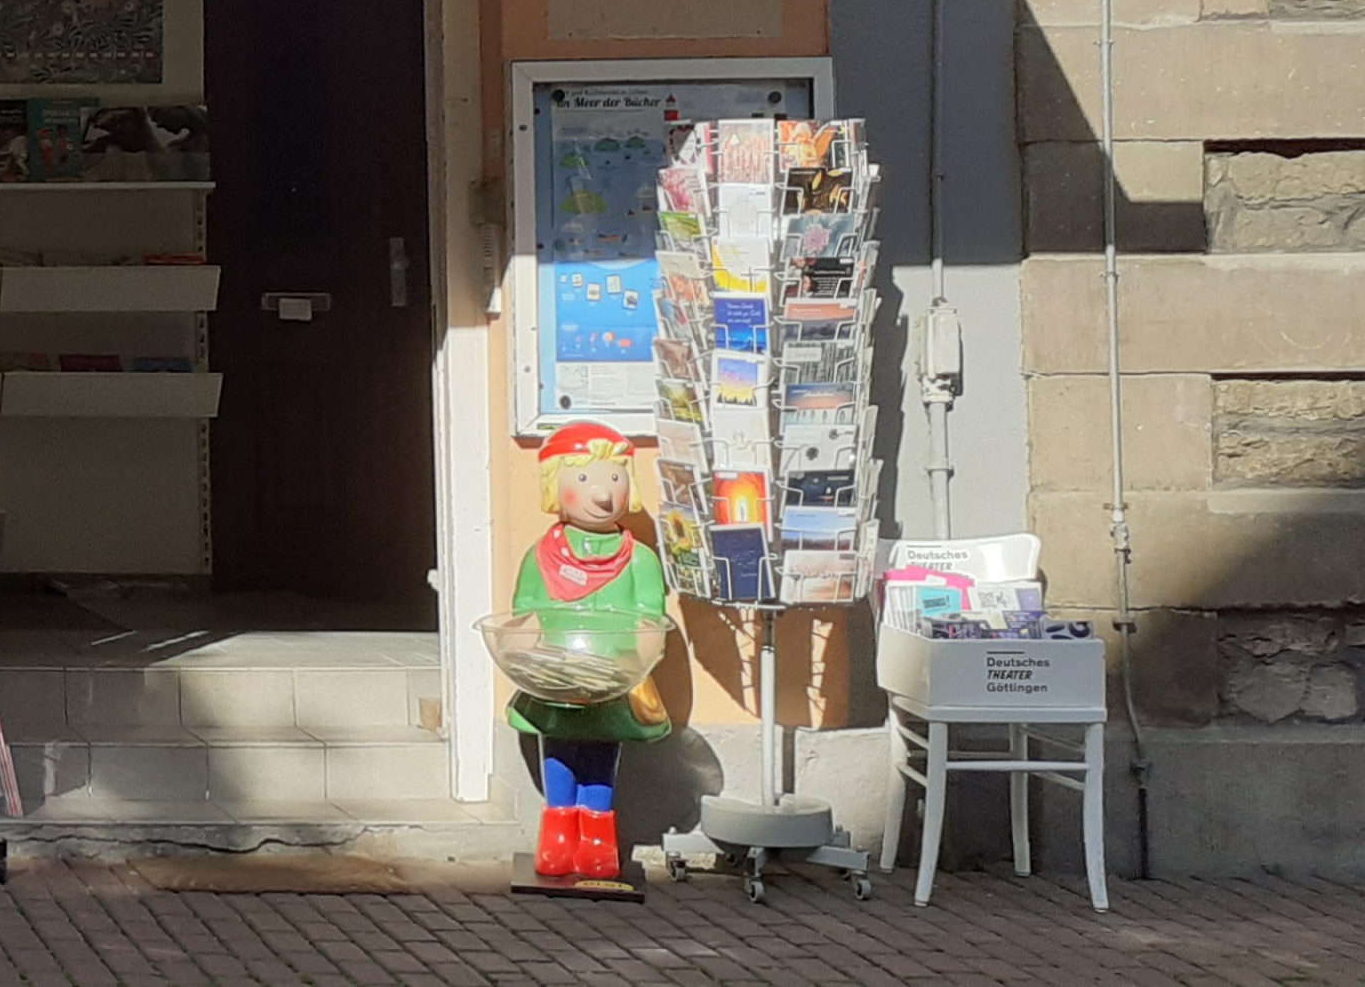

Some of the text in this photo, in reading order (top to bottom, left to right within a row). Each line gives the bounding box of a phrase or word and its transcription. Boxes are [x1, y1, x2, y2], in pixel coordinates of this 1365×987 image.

[573, 96, 601, 108] Meer
[603, 96, 621, 108] der
[624, 96, 661, 109] Bücher
[907, 550, 968, 559] Deutsches
[986, 657, 1050, 667] Deutsches
[987, 670, 1033, 680] THEATER
[986, 682, 1048, 694] Göttingen
